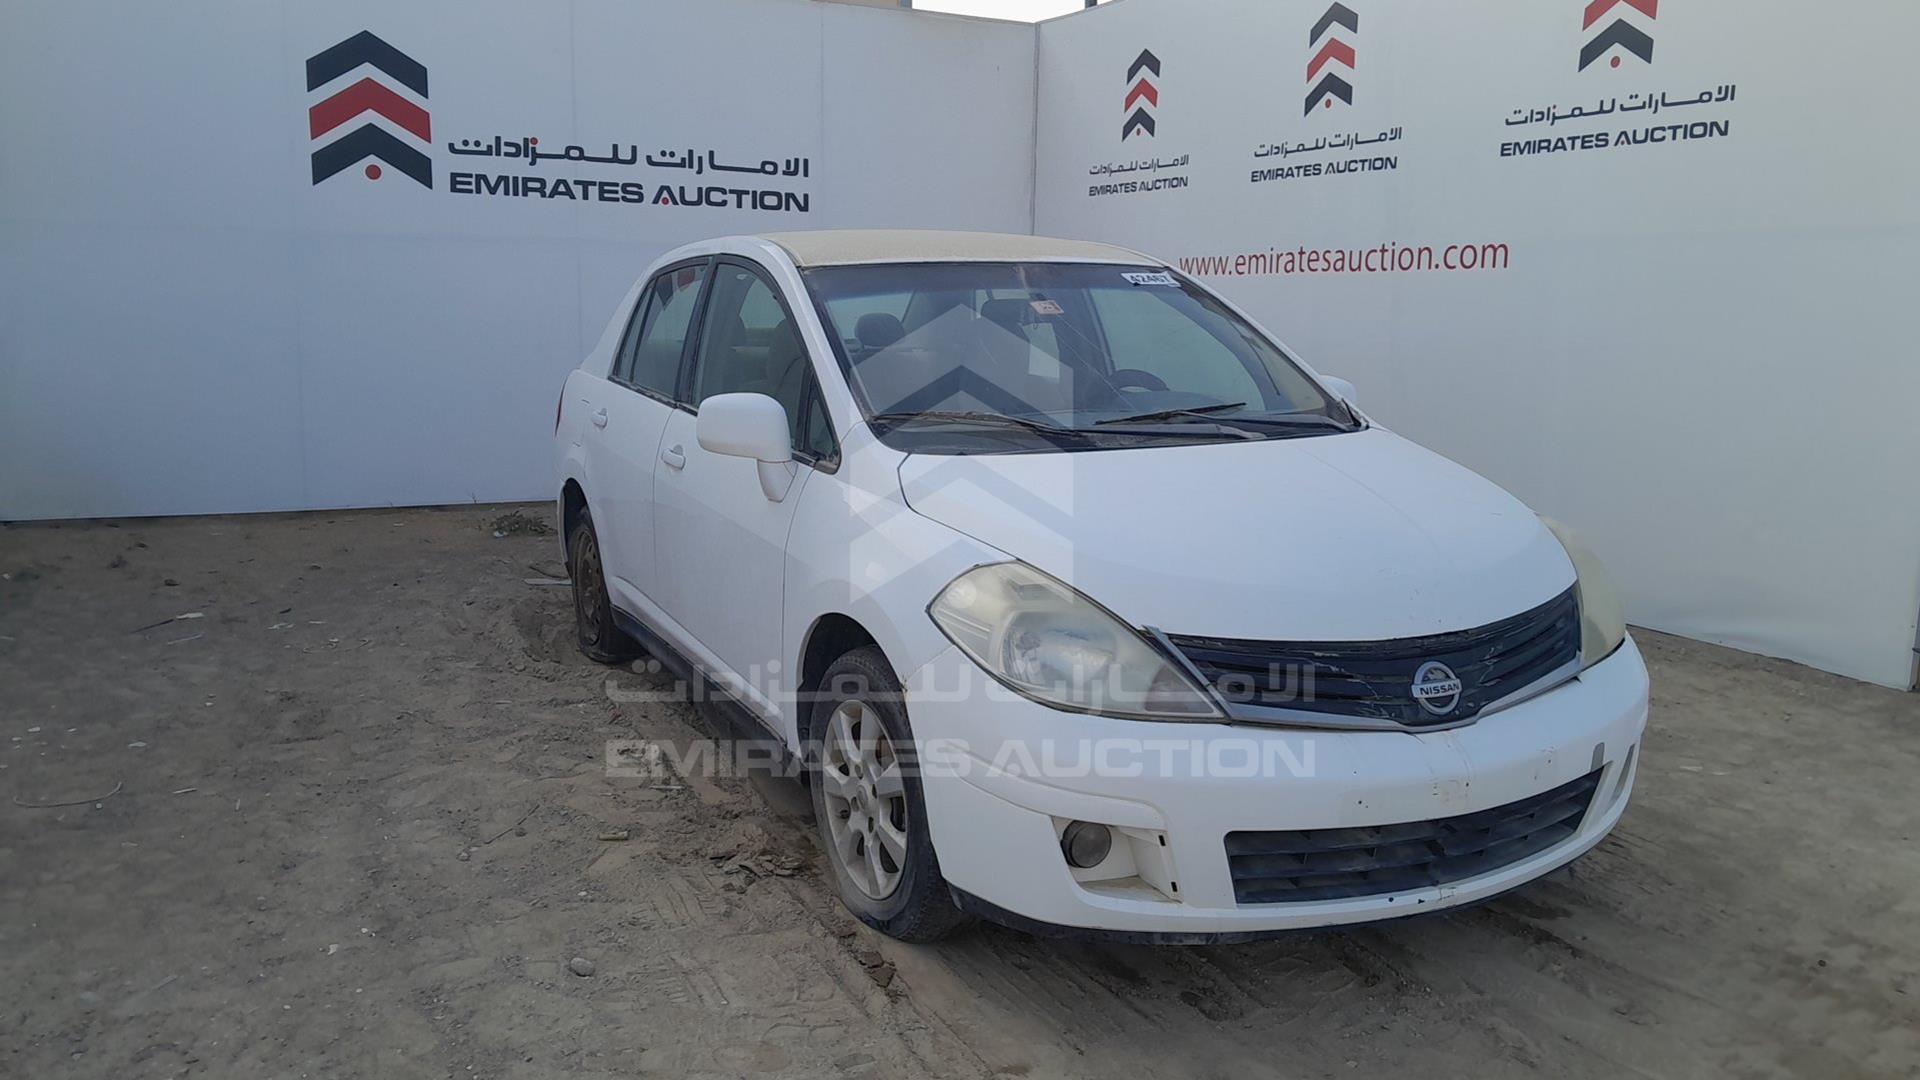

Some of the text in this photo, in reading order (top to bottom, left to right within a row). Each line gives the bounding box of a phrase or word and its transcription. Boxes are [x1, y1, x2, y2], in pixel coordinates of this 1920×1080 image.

[1505, 84, 1736, 126] الامارات للمزادات
[1254, 137, 1326, 159] للمزادات
[1500, 120, 1729, 157] EMIRATES AUCTION
[448, 135, 810, 178] الامارات للمزادات
[1250, 156, 1398, 183] EMIRATES AUCTION
[449, 172, 810, 212] EMIRATES AUCTION
[1089, 176, 1188, 197] EMIRATES AUCTION
[1179, 241, 1509, 276] www.emiratesauction.com
[1419, 683, 1460, 696] NISSAN
